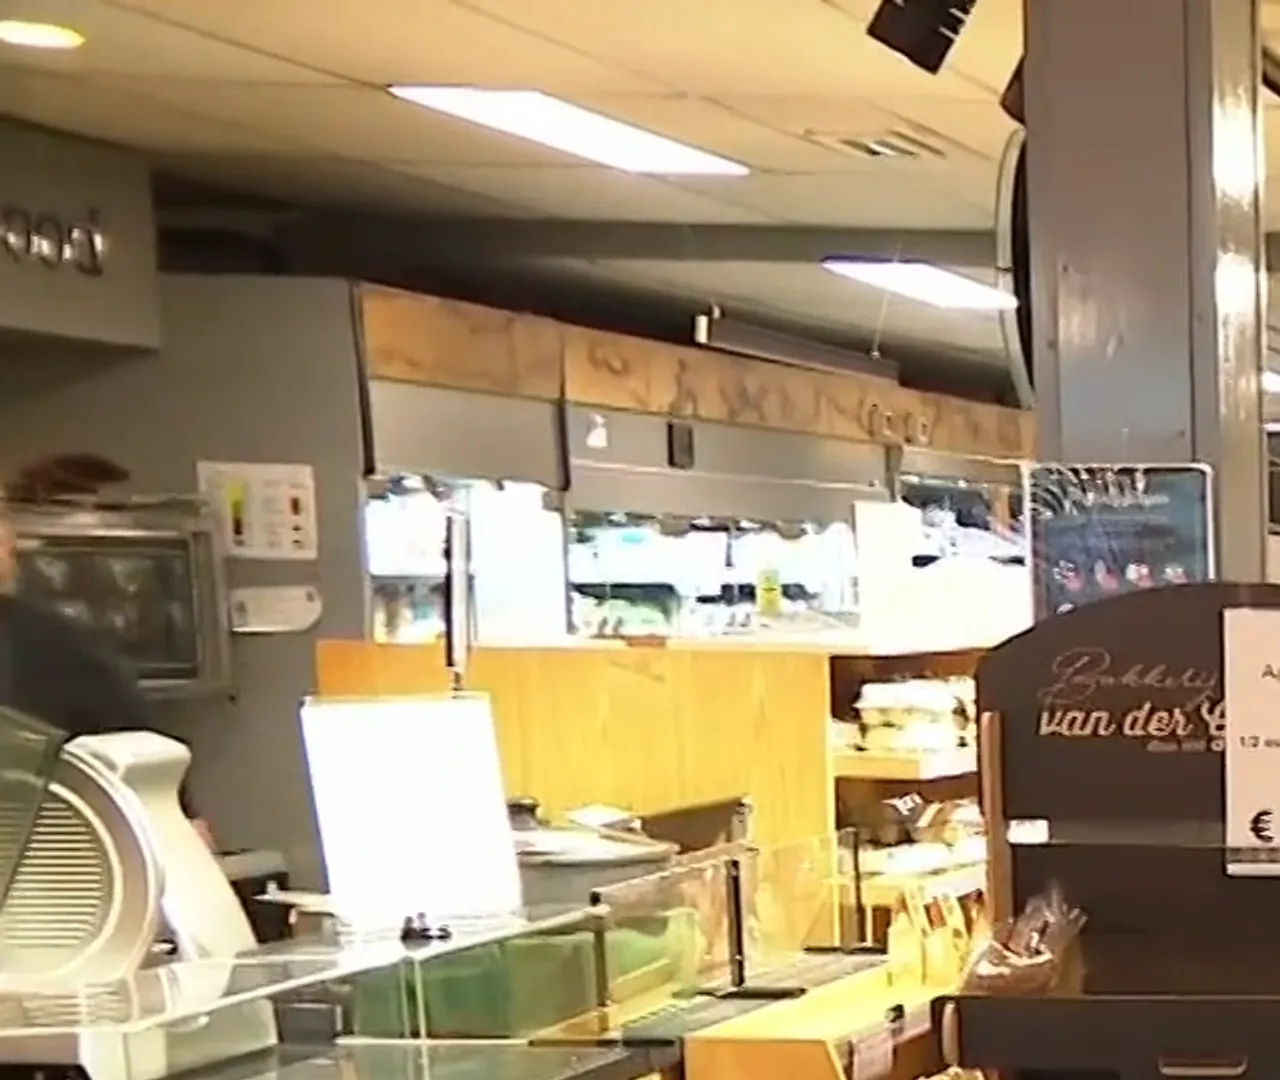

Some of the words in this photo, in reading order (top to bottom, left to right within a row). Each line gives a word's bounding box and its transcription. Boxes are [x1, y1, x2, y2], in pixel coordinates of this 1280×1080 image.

[1038, 709, 1116, 737] van
[1122, 701, 1194, 737] der
[1249, 809, 1275, 844] €
